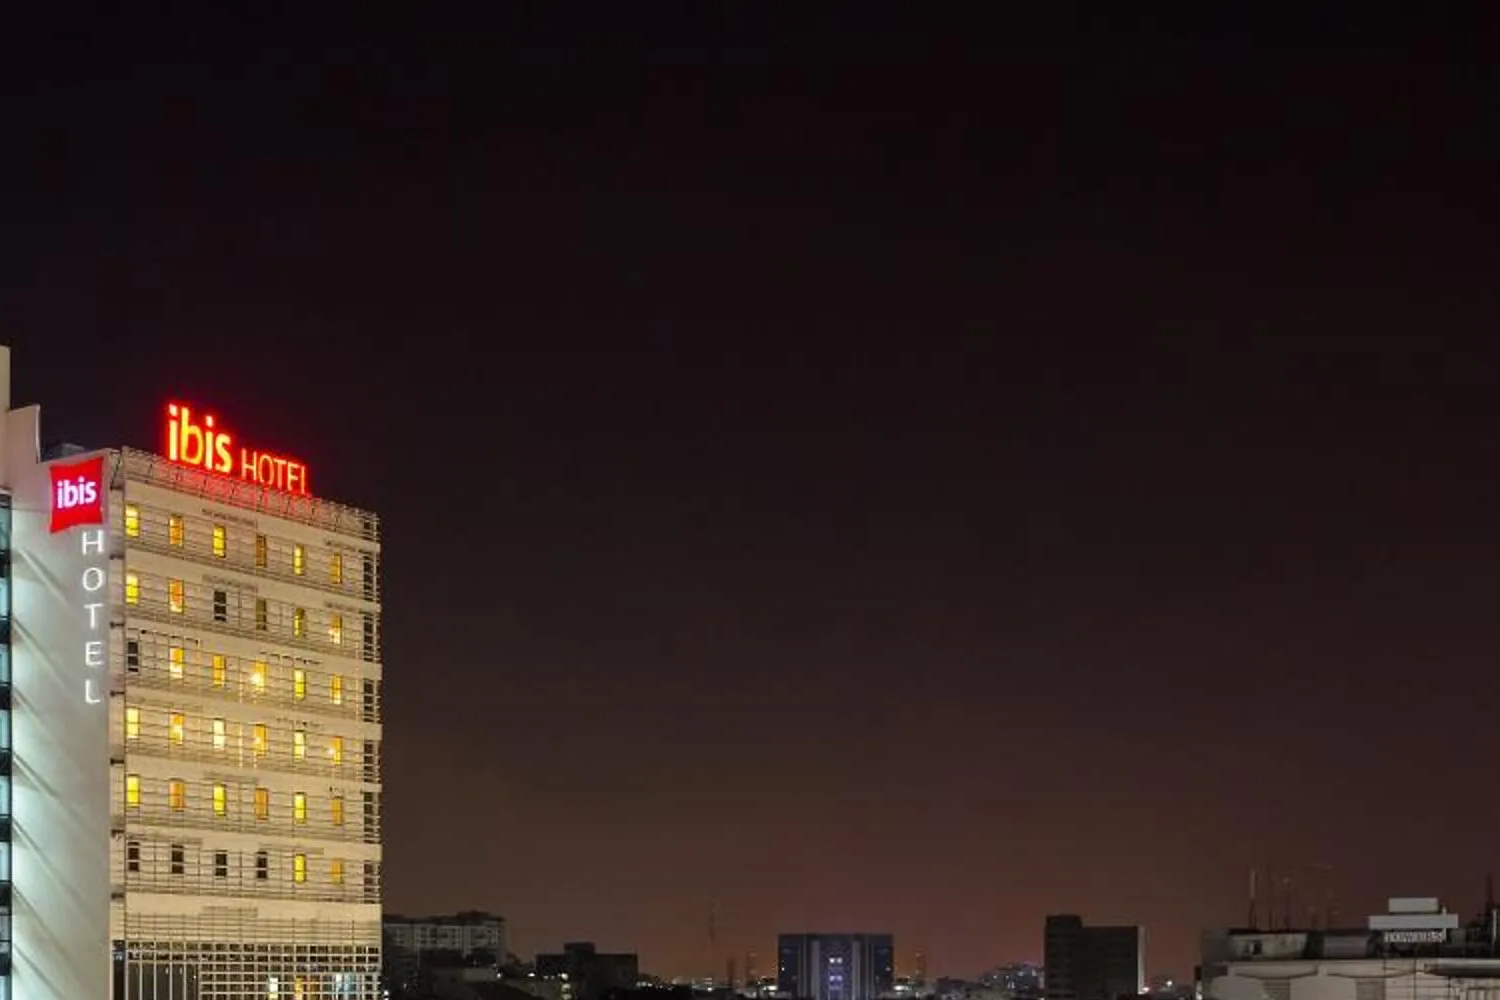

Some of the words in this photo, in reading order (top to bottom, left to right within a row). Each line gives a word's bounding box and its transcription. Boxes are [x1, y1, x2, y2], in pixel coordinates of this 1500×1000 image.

[56, 476, 97, 509] ibis
[167, 404, 233, 473] ibis
[241, 448, 309, 495] HOTEL
[81, 531, 104, 704] HOTEL
